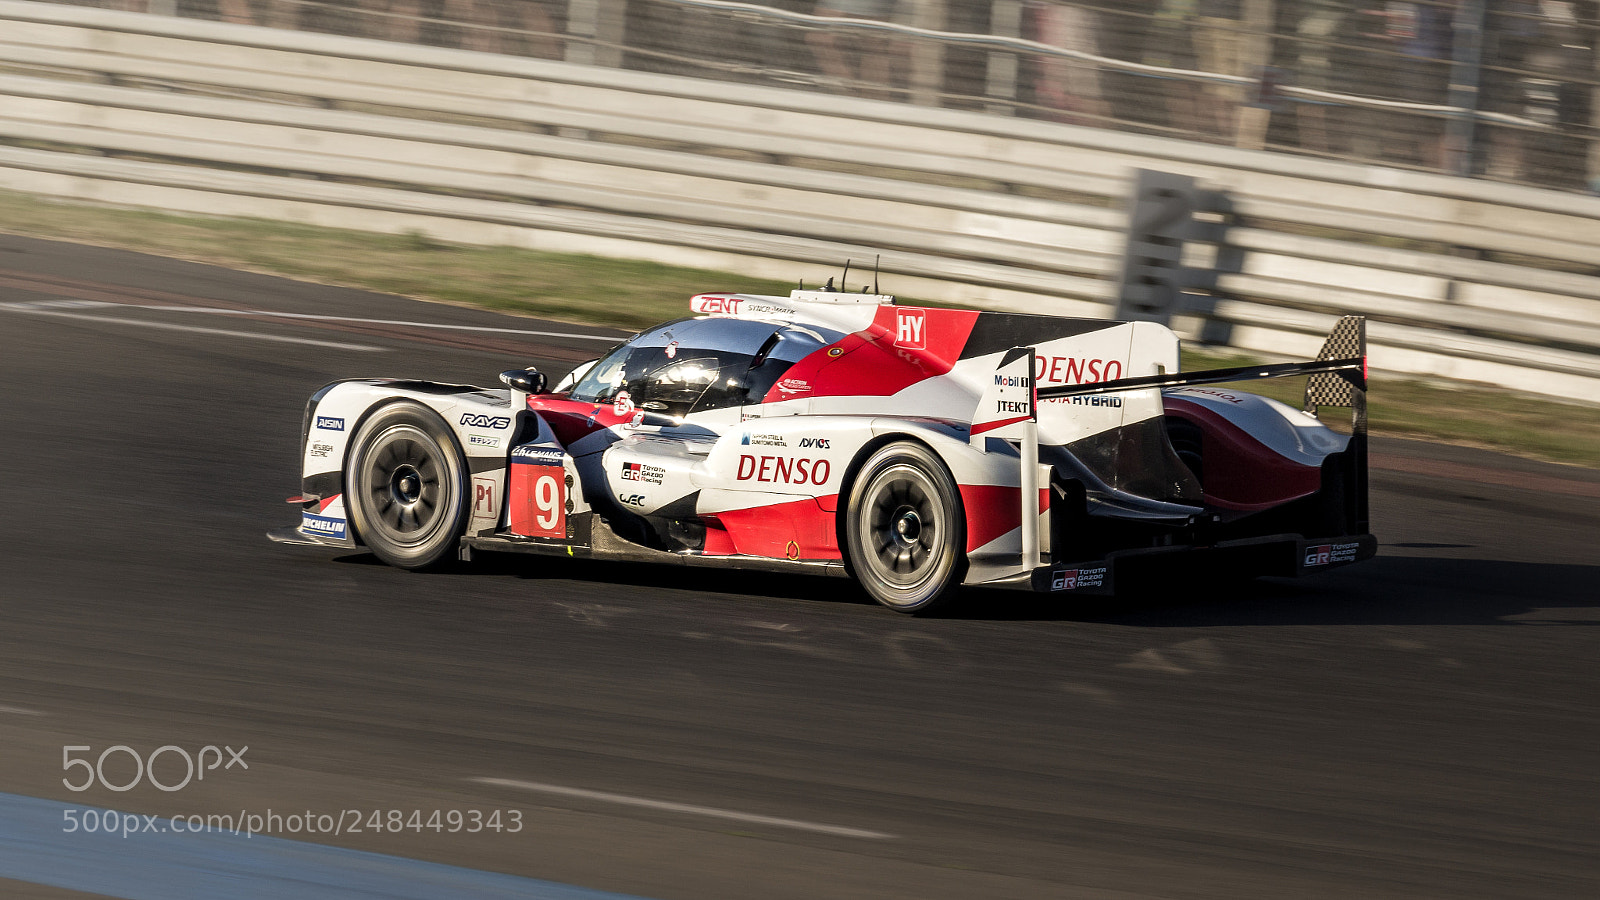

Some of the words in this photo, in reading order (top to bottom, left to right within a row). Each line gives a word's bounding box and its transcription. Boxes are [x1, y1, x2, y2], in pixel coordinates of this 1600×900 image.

[700, 296, 744, 314] ZENT
[898, 315, 924, 342] HY
[1035, 355, 1122, 384] DENSO
[994, 375, 1019, 387] Mobil
[997, 400, 1028, 413] JTEKT
[1073, 395, 1121, 408] HYBRID
[318, 418, 343, 429] AISIN
[460, 413, 511, 429] RAYS
[622, 469, 640, 481] GR
[641, 470, 664, 478] GAZOO
[642, 464, 666, 473] TOYOTA
[736, 454, 831, 486] DENSO
[641, 477, 663, 485] Racing
[476, 485, 493, 512] P1
[535, 475, 560, 530] 9
[619, 493, 646, 507] WEC
[1332, 542, 1359, 550] TOYOTA
[1305, 552, 1329, 564] GR
[1052, 577, 1076, 588] GR
